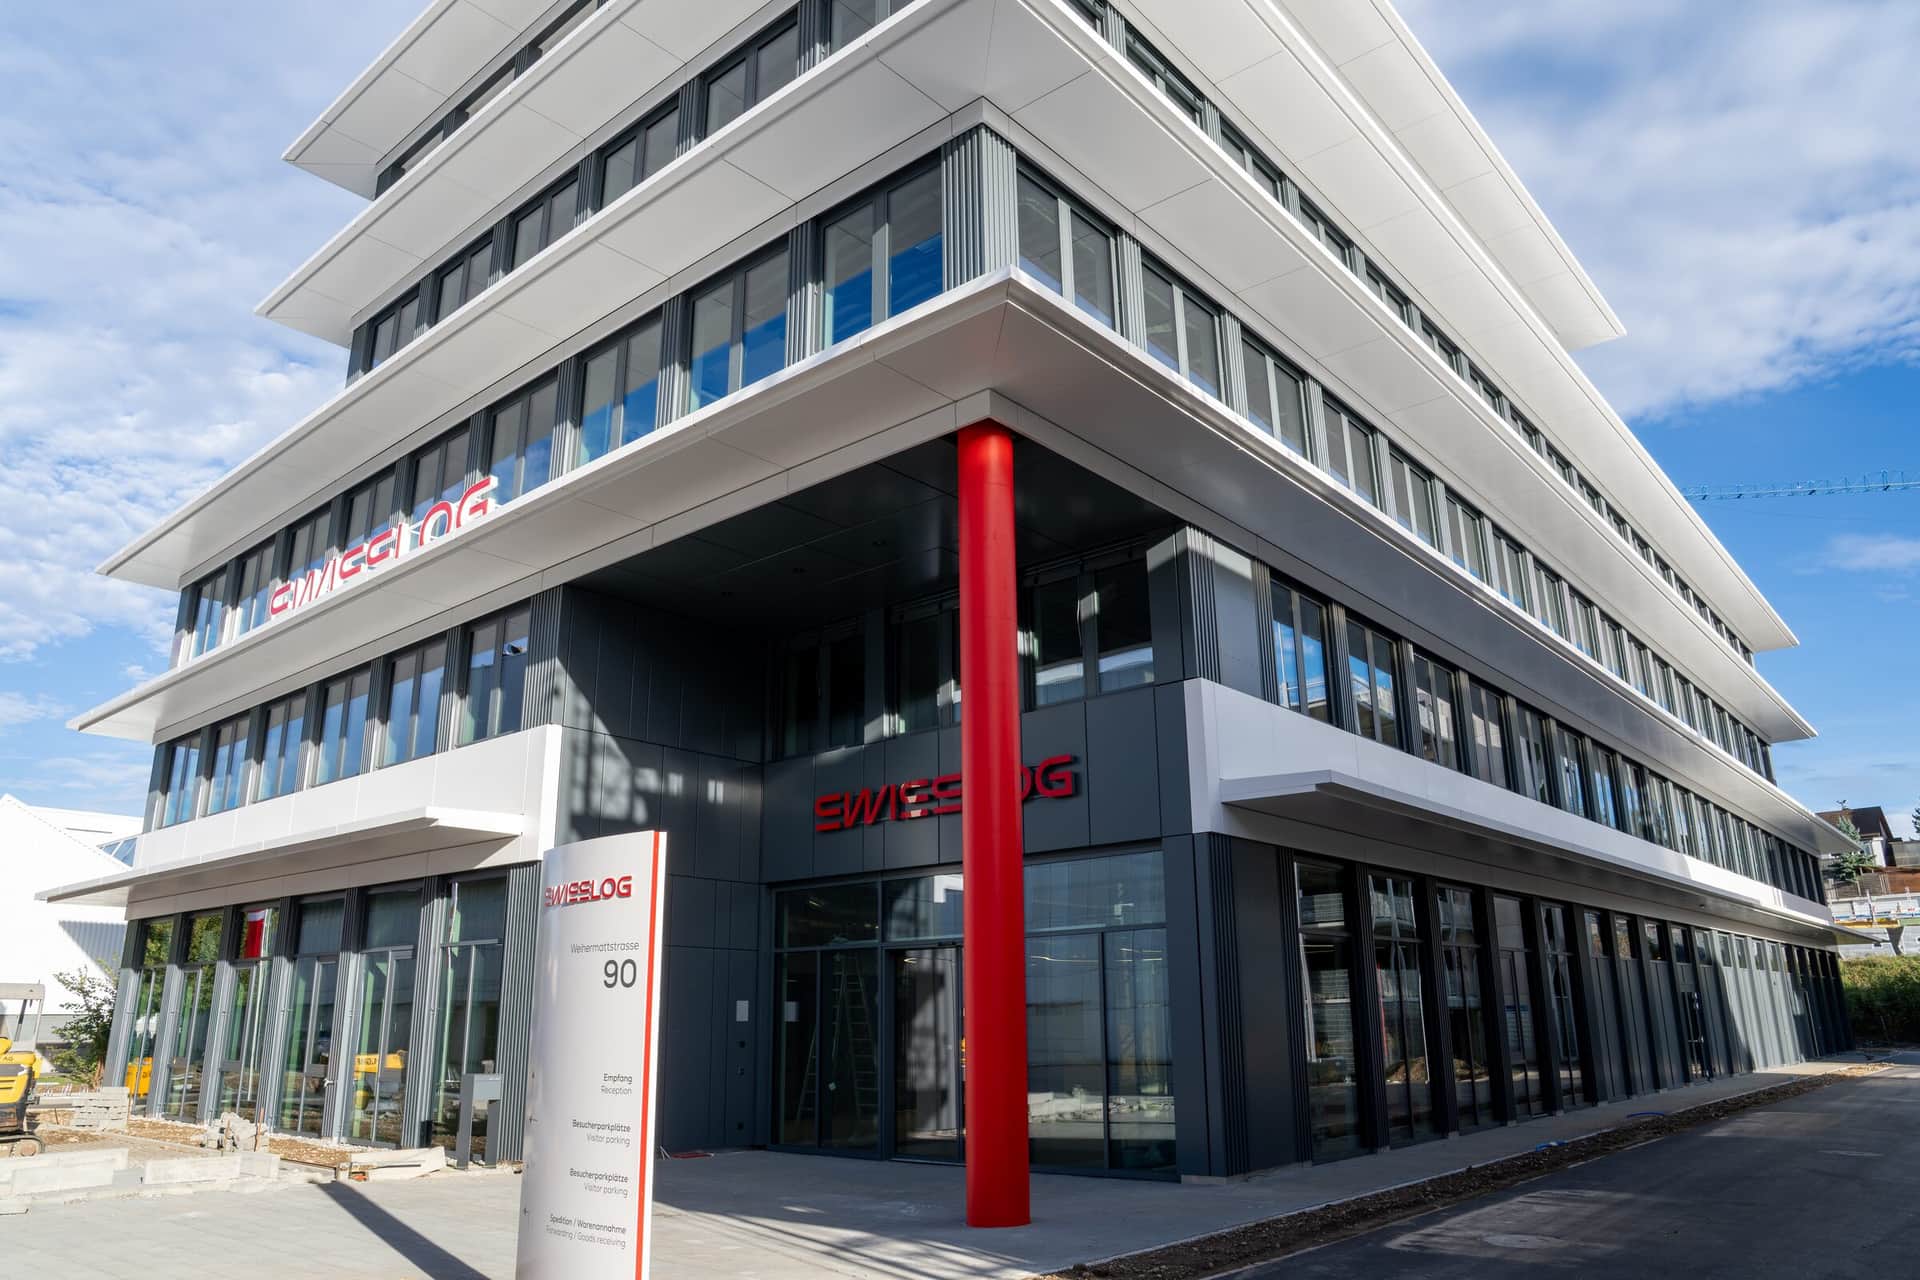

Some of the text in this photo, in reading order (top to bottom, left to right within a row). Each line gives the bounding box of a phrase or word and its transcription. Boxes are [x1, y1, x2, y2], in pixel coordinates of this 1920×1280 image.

[814, 753, 1074, 832] SWISSG
[544, 875, 633, 907] SWISSLOG
[603, 958, 637, 988] 90
[603, 1073, 633, 1085] Empfang
[601, 1085, 633, 1096] Reception
[606, 1136, 631, 1148] parking
[603, 1185, 628, 1199] parking
[577, 1219, 627, 1235] Warenannahme
